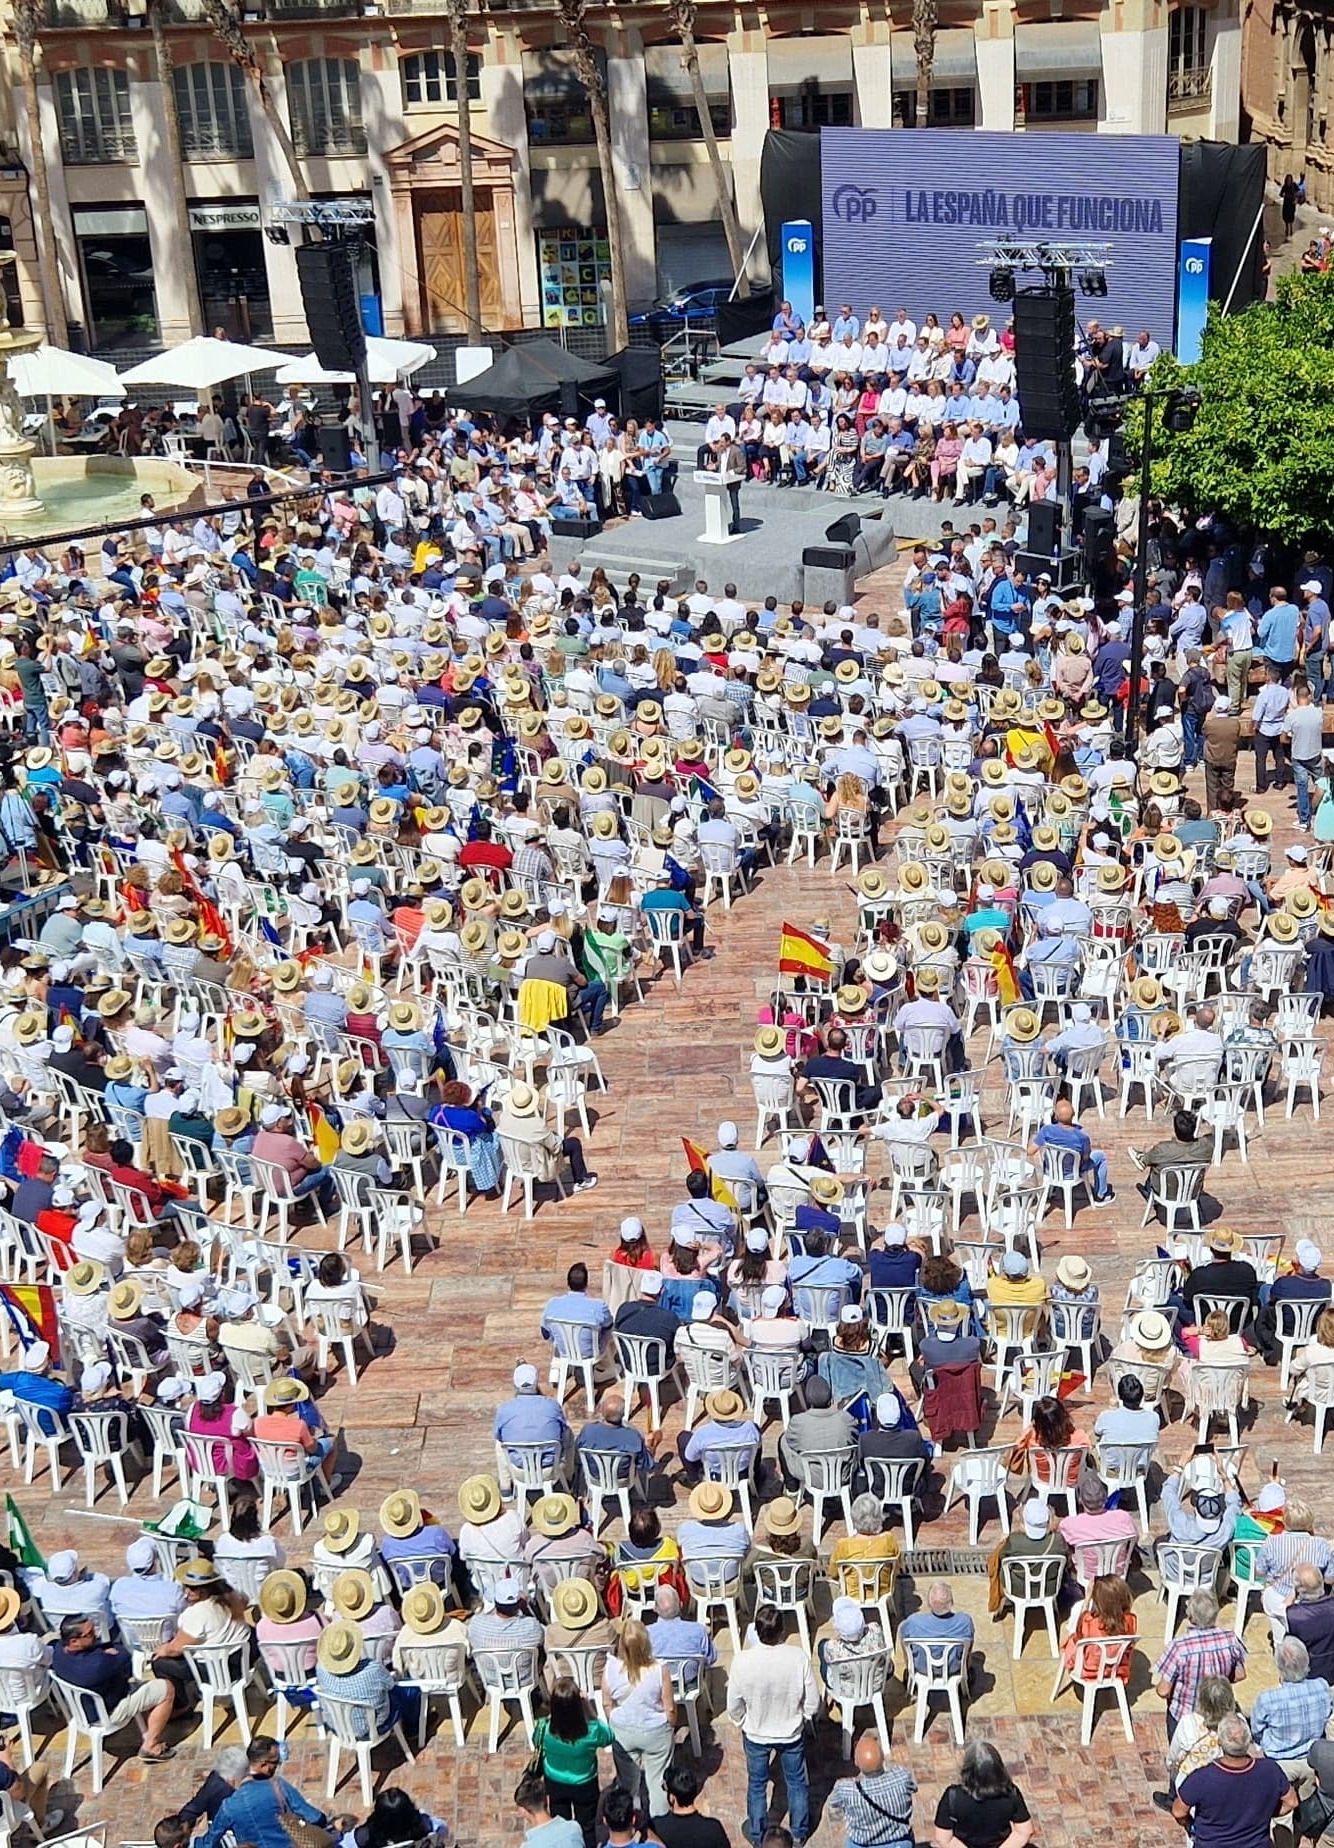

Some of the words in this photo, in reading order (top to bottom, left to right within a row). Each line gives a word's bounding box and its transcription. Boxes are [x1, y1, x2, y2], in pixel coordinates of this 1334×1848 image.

[192, 212, 259, 226] NESPRESSO
[905, 190, 930, 223] LA
[932, 188, 1009, 227] ESPAÑA
[1014, 193, 1055, 233] QUE
[1056, 196, 1164, 233] FUNCIONA
